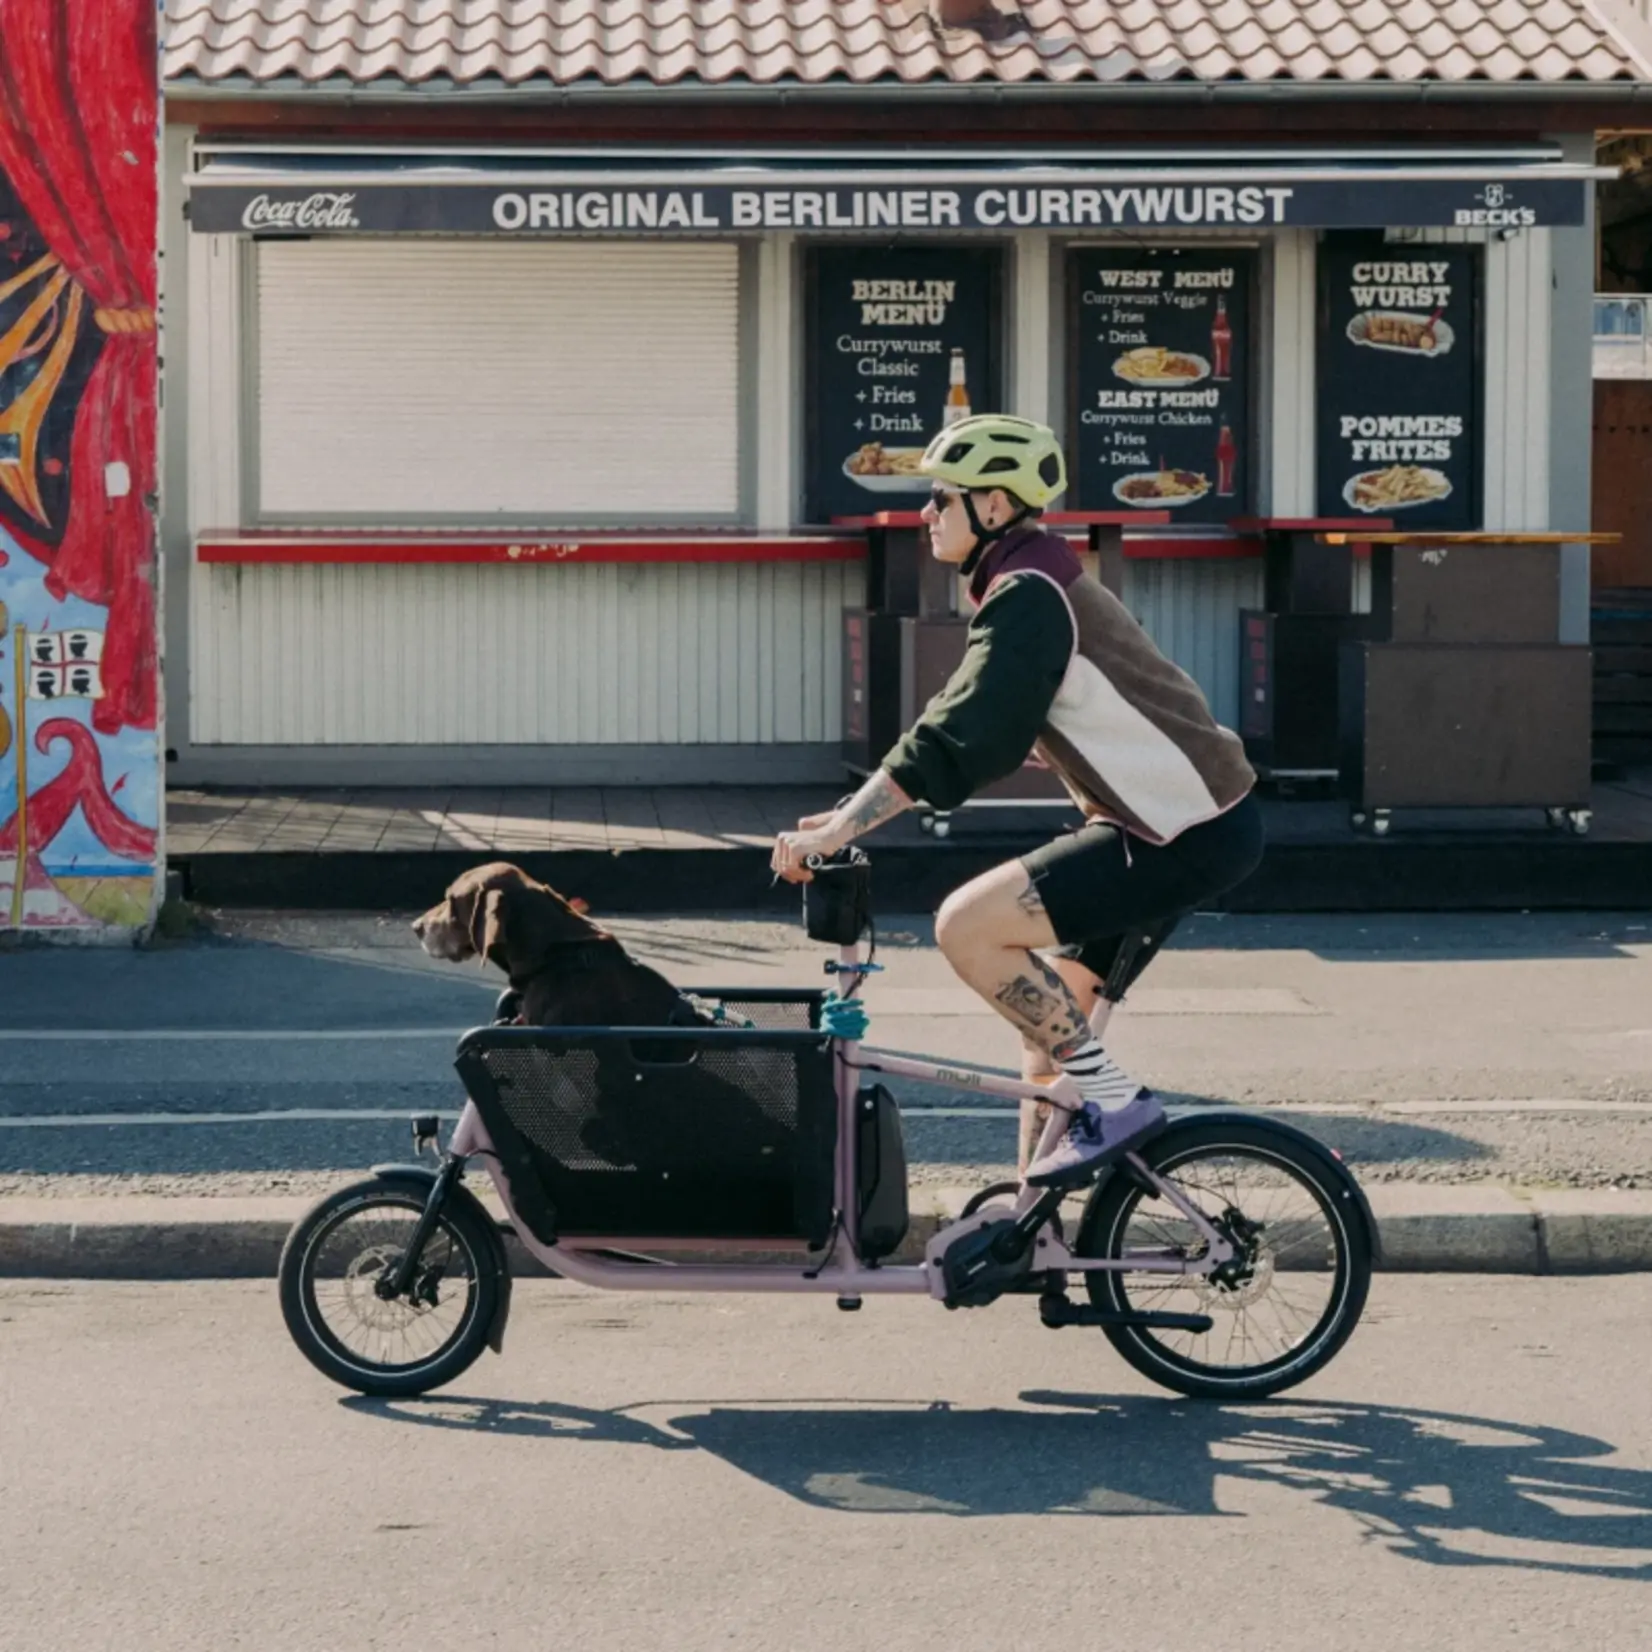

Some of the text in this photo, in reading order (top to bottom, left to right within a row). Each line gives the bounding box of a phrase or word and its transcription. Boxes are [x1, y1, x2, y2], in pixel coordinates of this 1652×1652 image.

[242, 192, 357, 229] Coca-Cola
[492, 188, 1293, 229] ORIGINAL BERLINER CURRYWURST
[1454, 206, 1536, 226] BECK'S
[1099, 268, 1235, 288] WEST MENÜ
[1352, 262, 1450, 283] CURRY
[852, 280, 956, 302] BERLIN
[1083, 290, 1208, 309] Currywurst Veggie
[1350, 286, 1452, 307] WURST
[1112, 309, 1145, 324] Fries
[836, 334, 943, 358] Currywurst
[1109, 330, 1148, 344] Drink
[857, 357, 920, 377] Classic
[872, 385, 916, 405] Fries
[1098, 388, 1220, 408] EAST MENÜ
[870, 414, 924, 432] Drink
[1081, 410, 1213, 427] Currywurst Chicken
[1340, 416, 1463, 438] POMMES
[1114, 431, 1147, 445] Fries
[1111, 451, 1151, 466] Drink
[1352, 439, 1452, 461] FRITES
